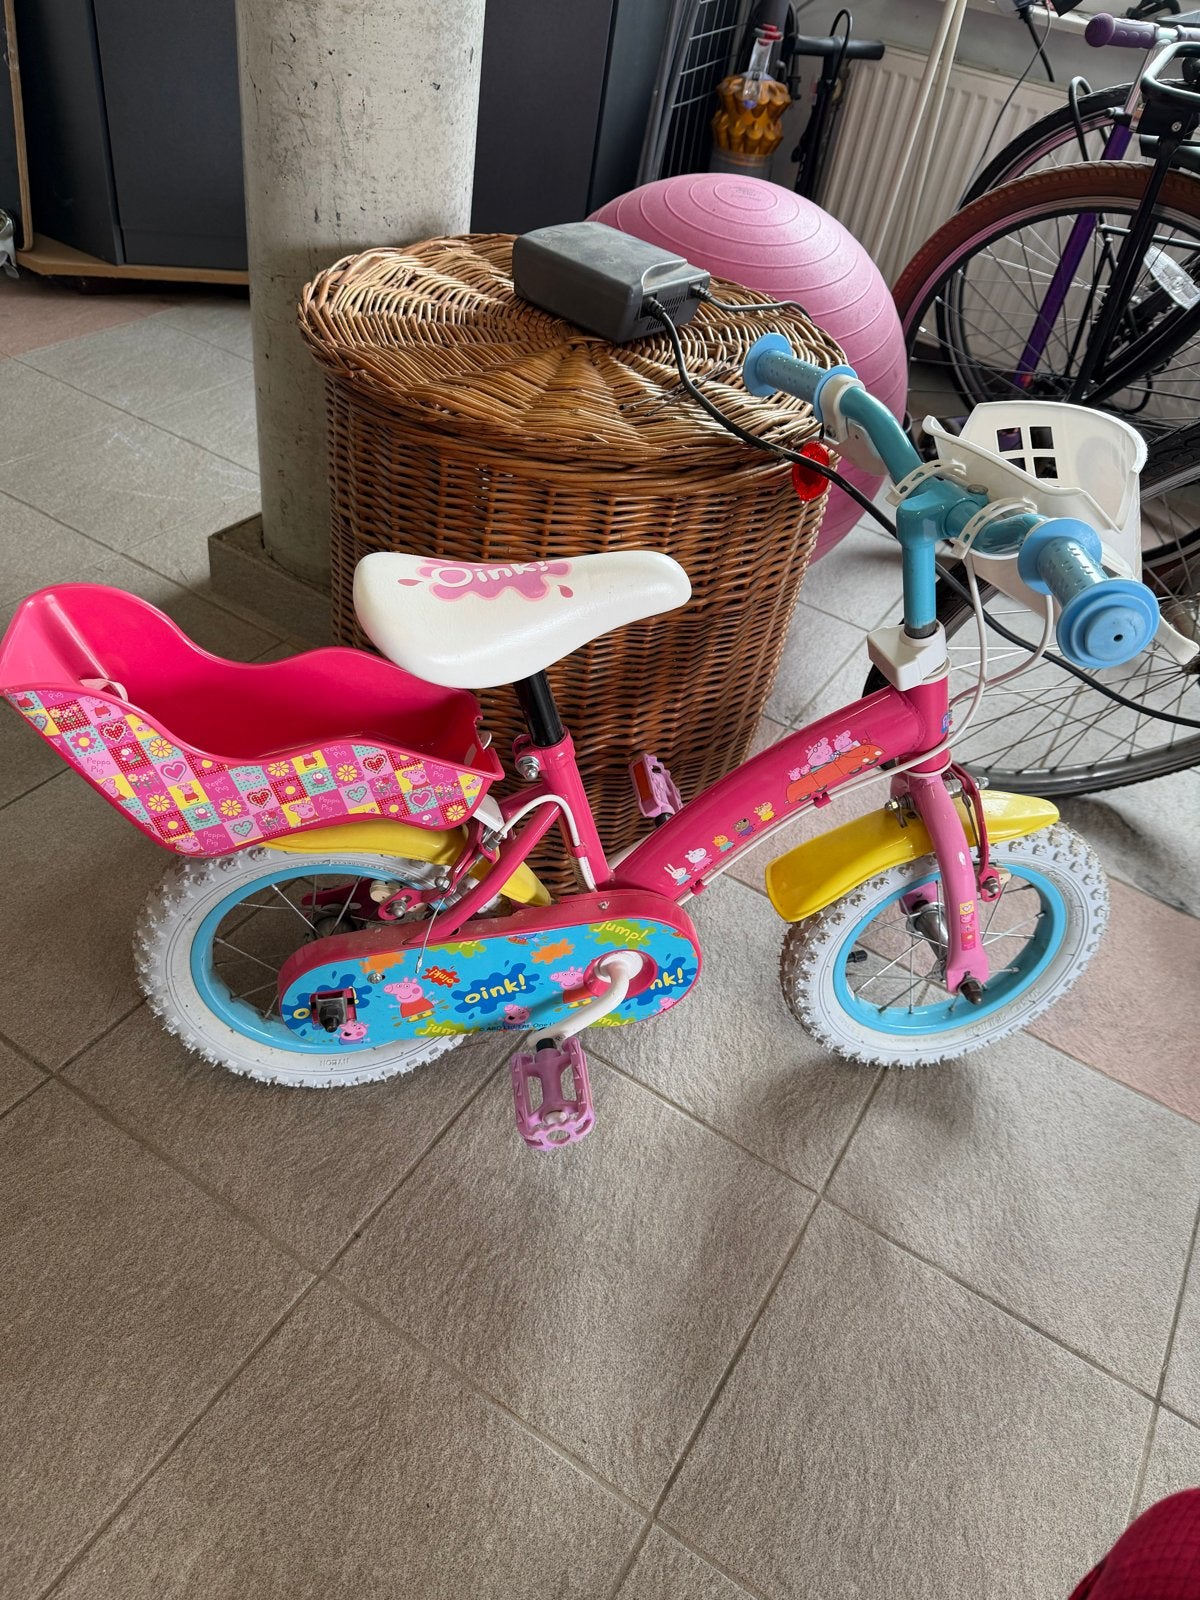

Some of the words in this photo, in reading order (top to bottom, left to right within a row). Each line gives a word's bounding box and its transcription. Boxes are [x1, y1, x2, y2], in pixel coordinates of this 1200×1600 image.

[87, 757, 111, 767] Peppa
[91, 765, 104, 775] Pig
[203, 830, 226, 840] Peppa
[206, 839, 219, 847] Pig
[649, 967, 684, 991] nk!
